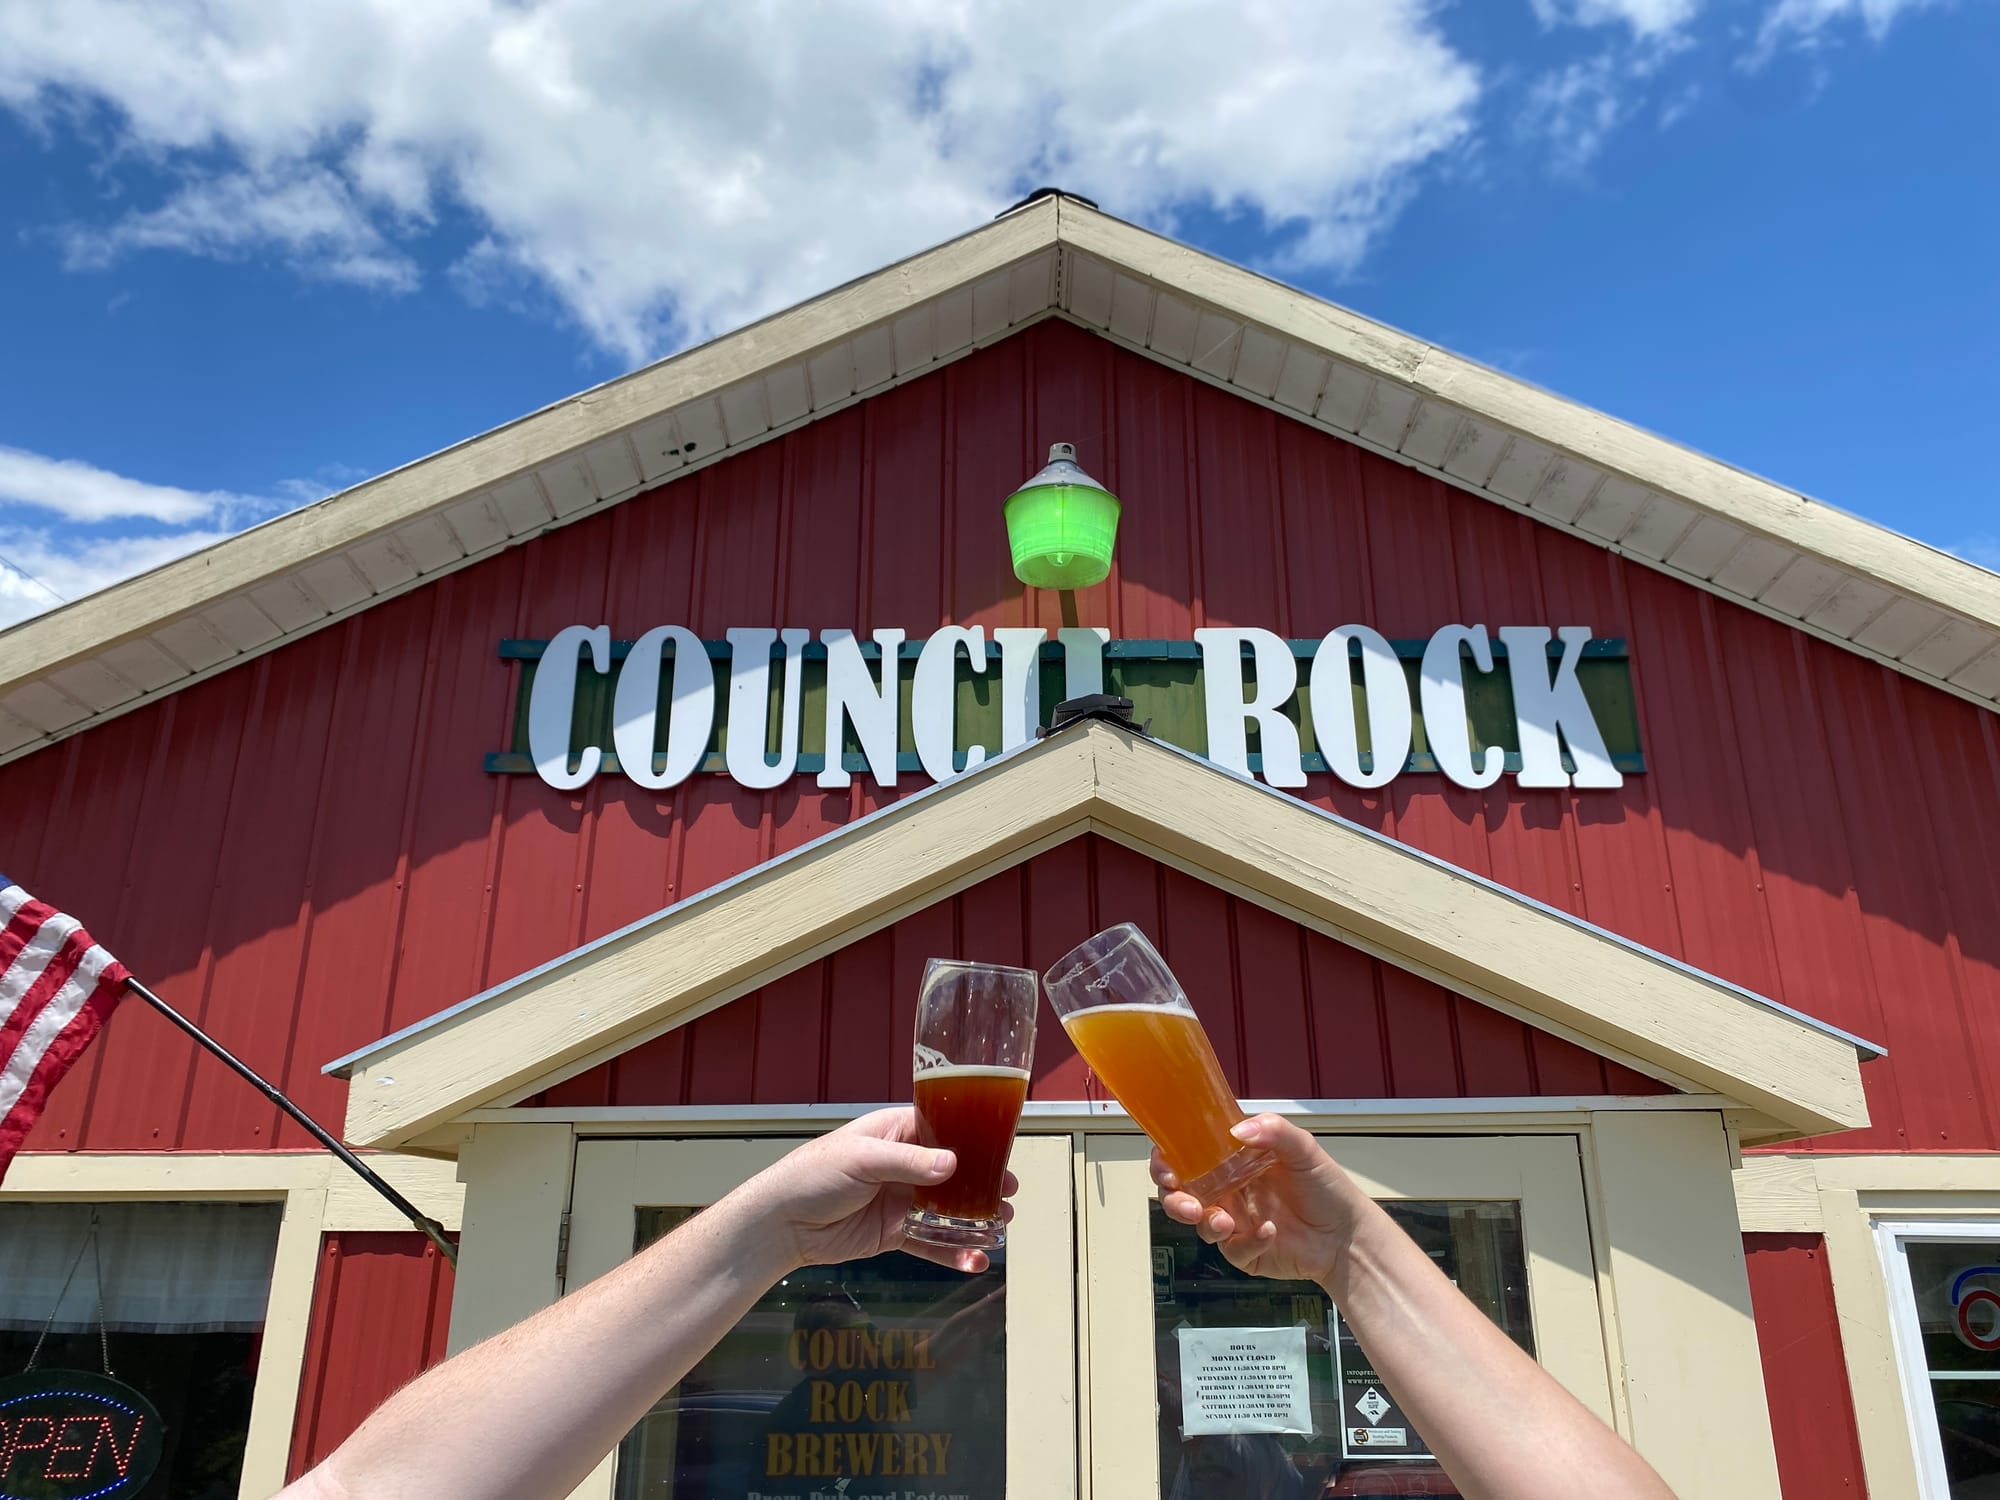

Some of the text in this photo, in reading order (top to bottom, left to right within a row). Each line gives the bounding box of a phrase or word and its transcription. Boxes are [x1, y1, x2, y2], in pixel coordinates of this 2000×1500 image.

[1194, 623, 1624, 790] ROCK
[788, 1328, 937, 1371] COUNCIL
[810, 1380, 913, 1424] ROCK
[765, 1433, 953, 1477] BREWERY
